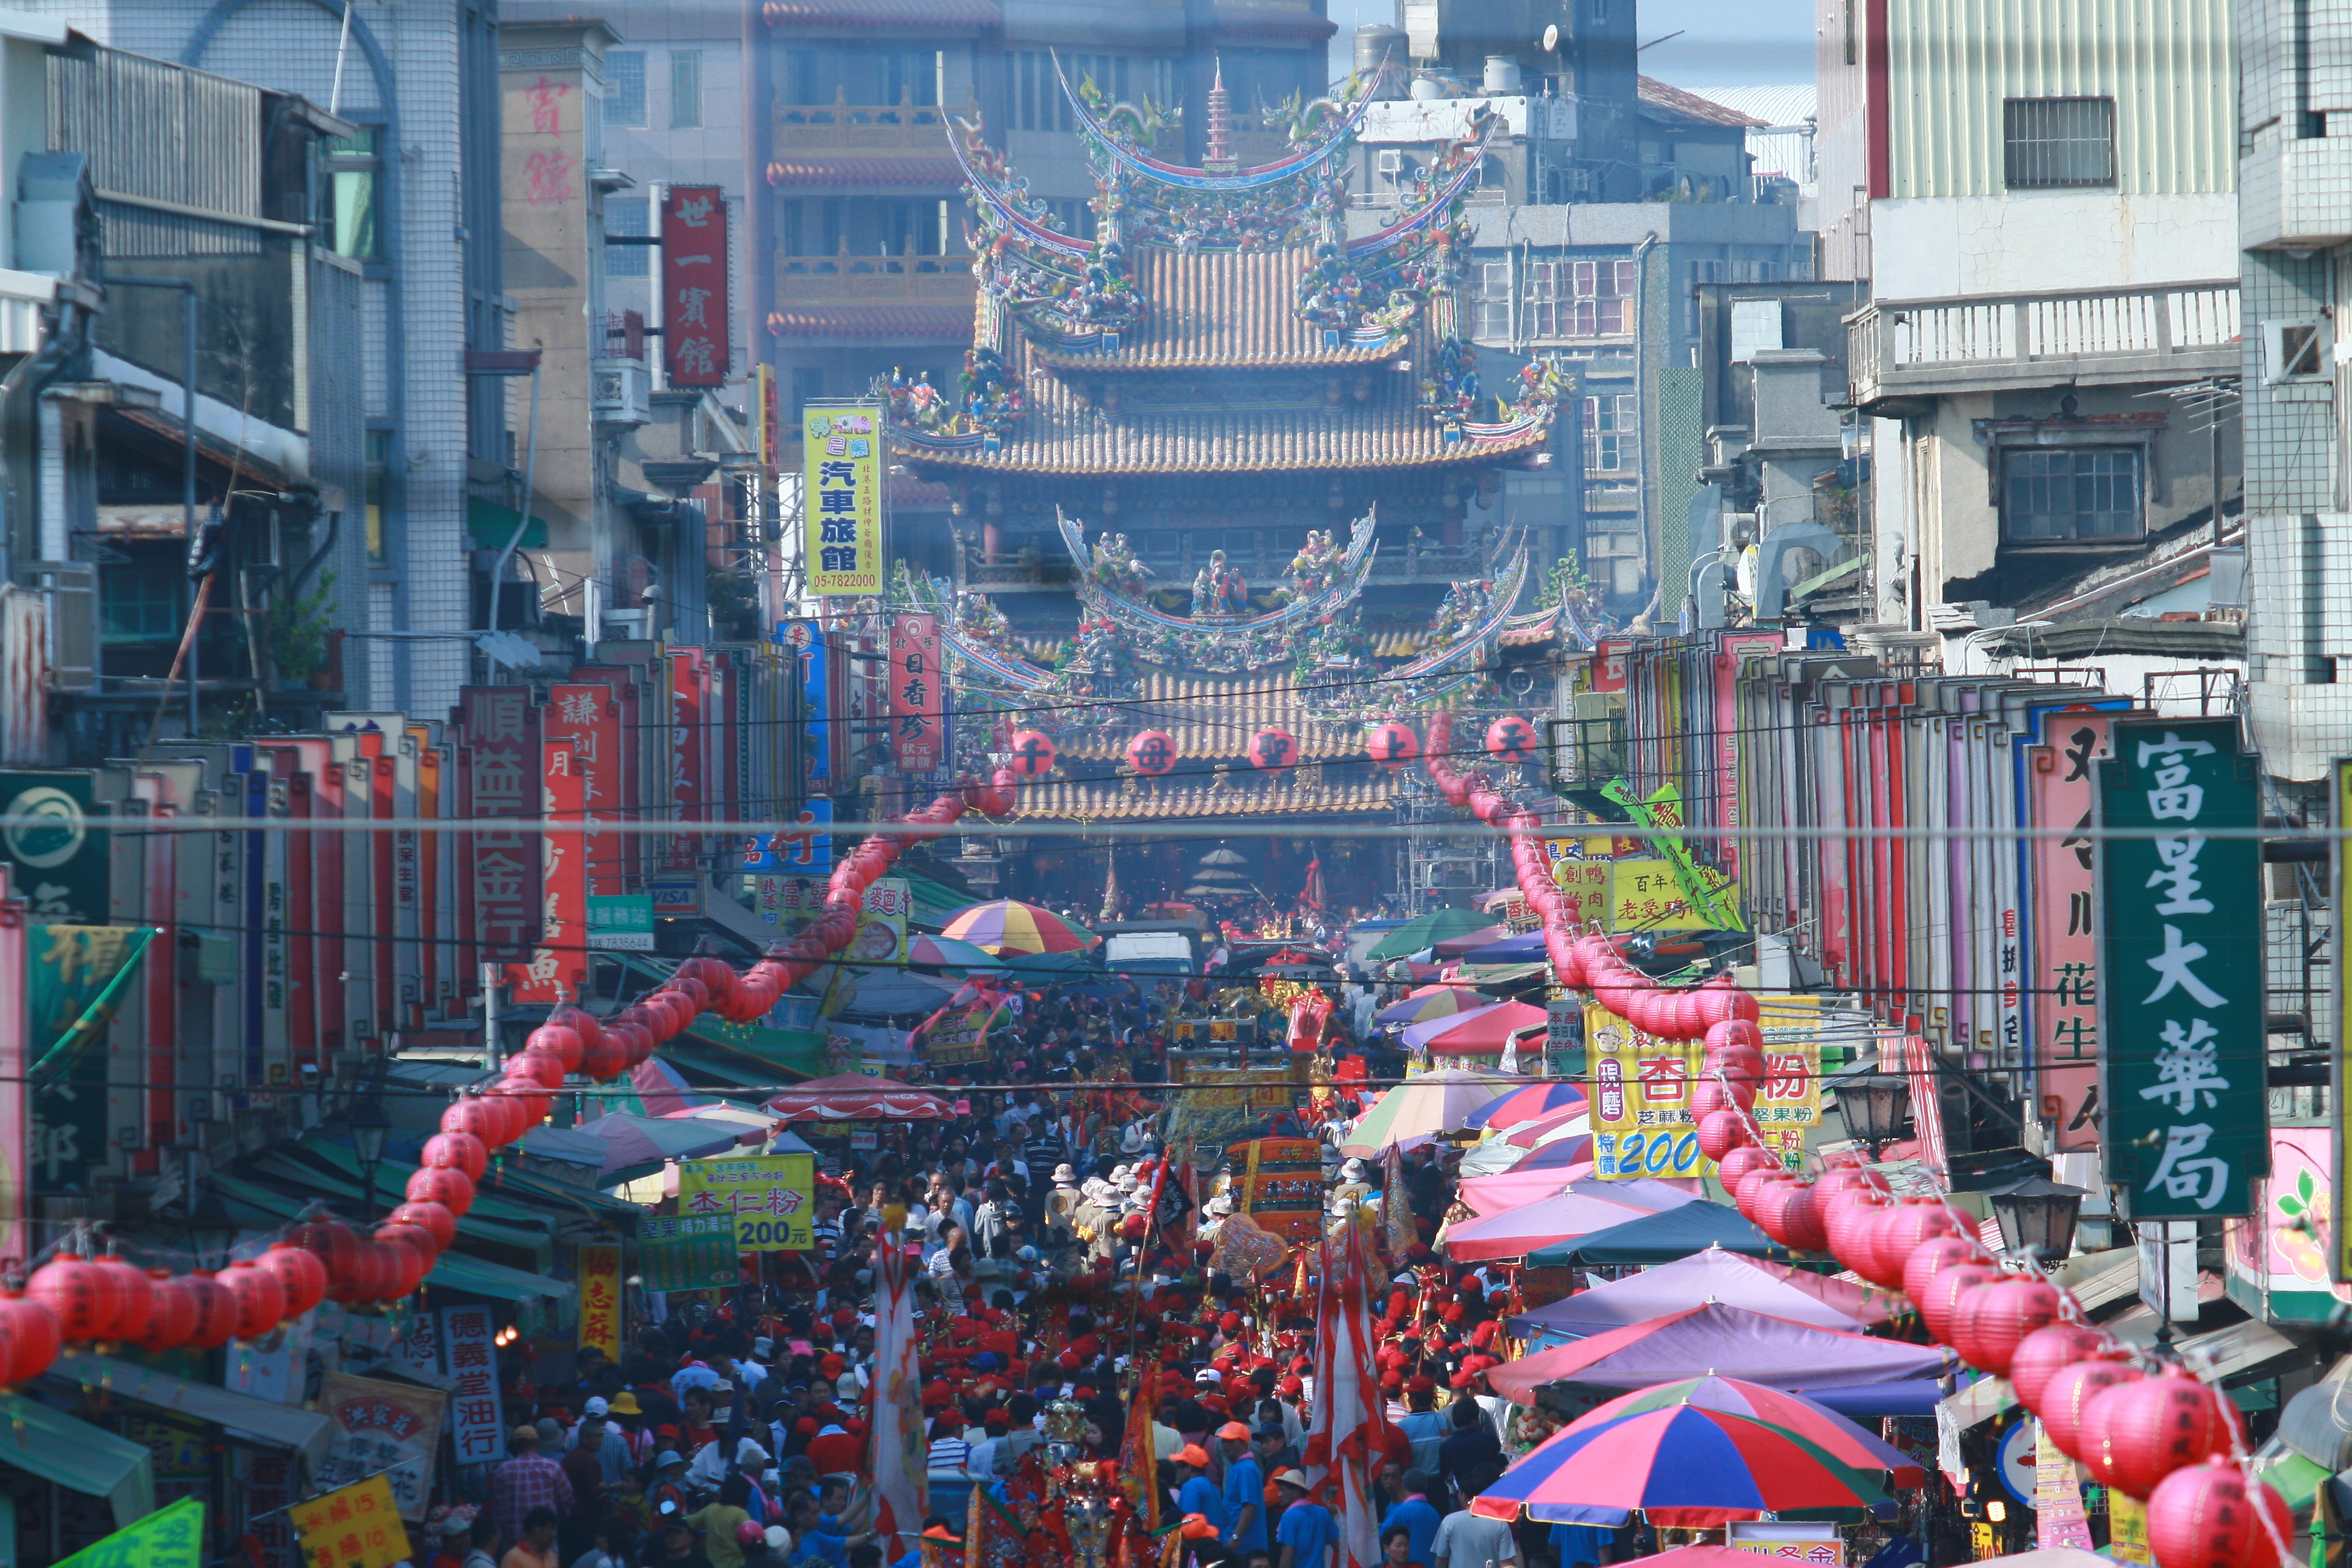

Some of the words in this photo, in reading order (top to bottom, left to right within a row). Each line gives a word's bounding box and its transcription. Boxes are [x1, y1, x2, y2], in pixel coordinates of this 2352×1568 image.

[675, 195, 716, 376] 世一賓館
[818, 460, 857, 572] 汽車旅館
[814, 574, 875, 587] 05-7822000
[895, 636, 935, 650] 北港
[898, 652, 933, 742] 日香珍
[901, 743, 930, 756] 狀元
[469, 693, 526, 956] 順益五金行
[650, 889, 690, 905] VISA
[2137, 730, 2230, 1210] 富星大藥局
[1599, 1063, 1620, 1116] 現磨
[1751, 1106, 1814, 1123] 堅果粉
[1597, 1134, 1617, 1175] 特價
[686, 1187, 805, 1218] 杏仁粉
[641, 1219, 678, 1240] 堅果
[680, 1216, 719, 1234] 精力湯
[737, 1221, 808, 1245] 200元
[448, 1312, 498, 1457] 德義堂油行
